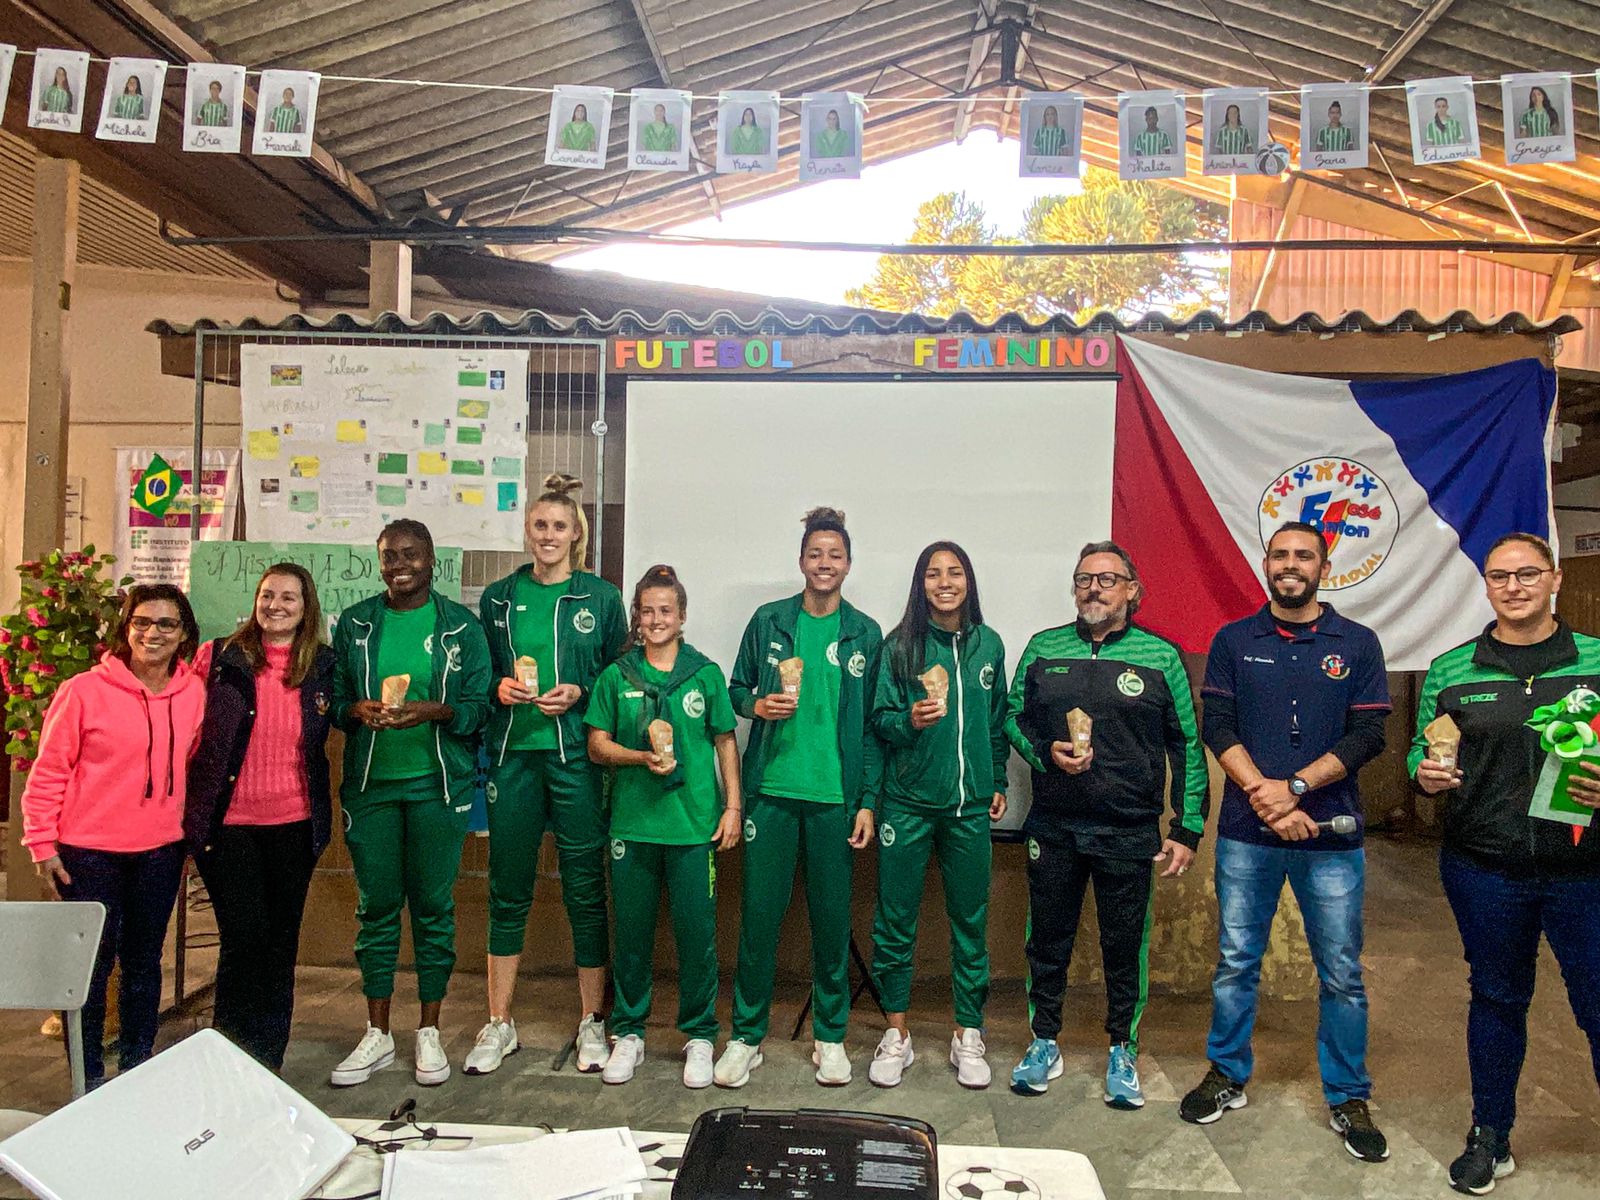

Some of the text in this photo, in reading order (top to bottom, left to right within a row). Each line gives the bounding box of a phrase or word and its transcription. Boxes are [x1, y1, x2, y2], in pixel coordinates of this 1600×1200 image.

[191, 131, 221, 149] Bia
[1314, 154, 1346, 167] Sara
[1422, 147, 1478, 162] Eduarda
[1127, 158, 1171, 174] Thalita
[614, 337, 1110, 368] FUTEBOL FEMININO
[184, 1129, 216, 1156] ASUS
[787, 1147, 827, 1156] EPSON
